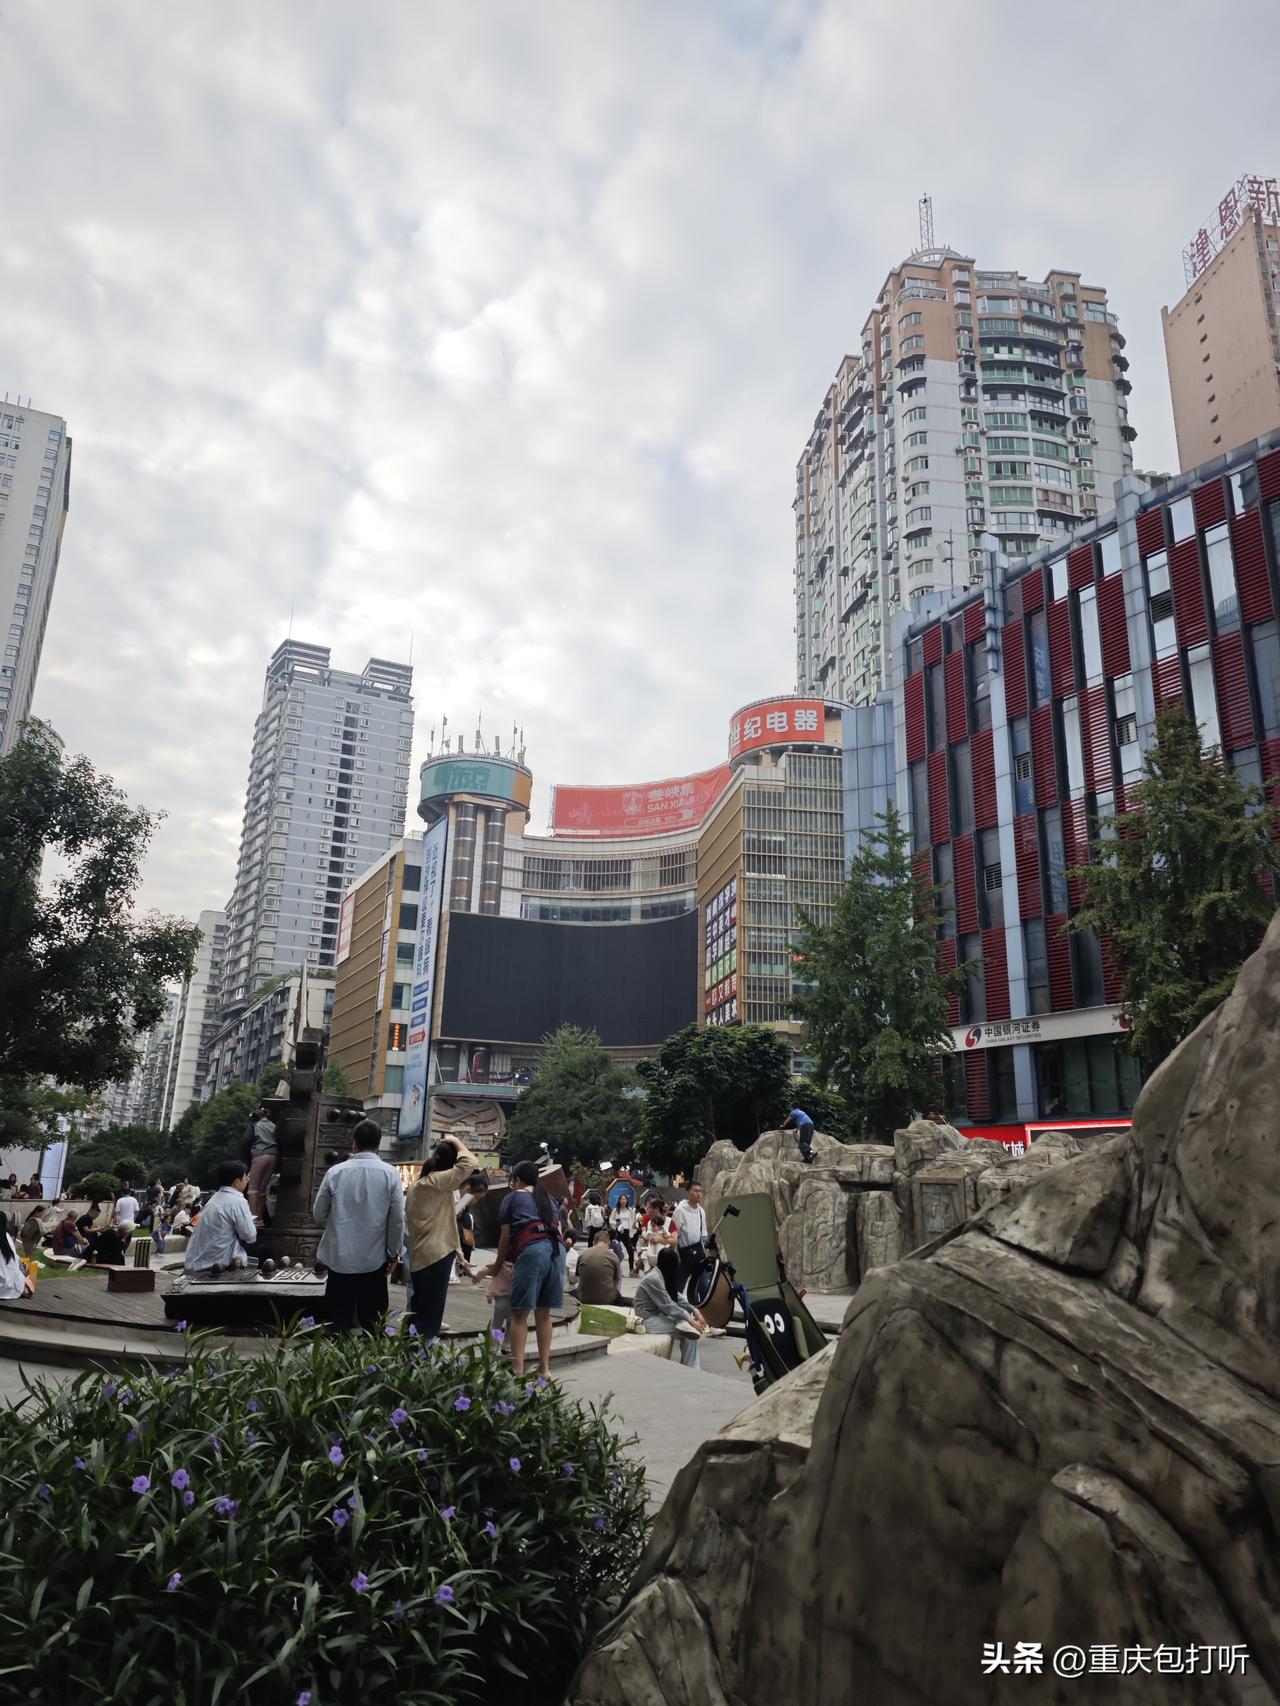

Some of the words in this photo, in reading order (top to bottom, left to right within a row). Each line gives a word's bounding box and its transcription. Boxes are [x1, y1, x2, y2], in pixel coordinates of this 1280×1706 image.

[985, 1020, 1041, 1038] 中国银河证券
